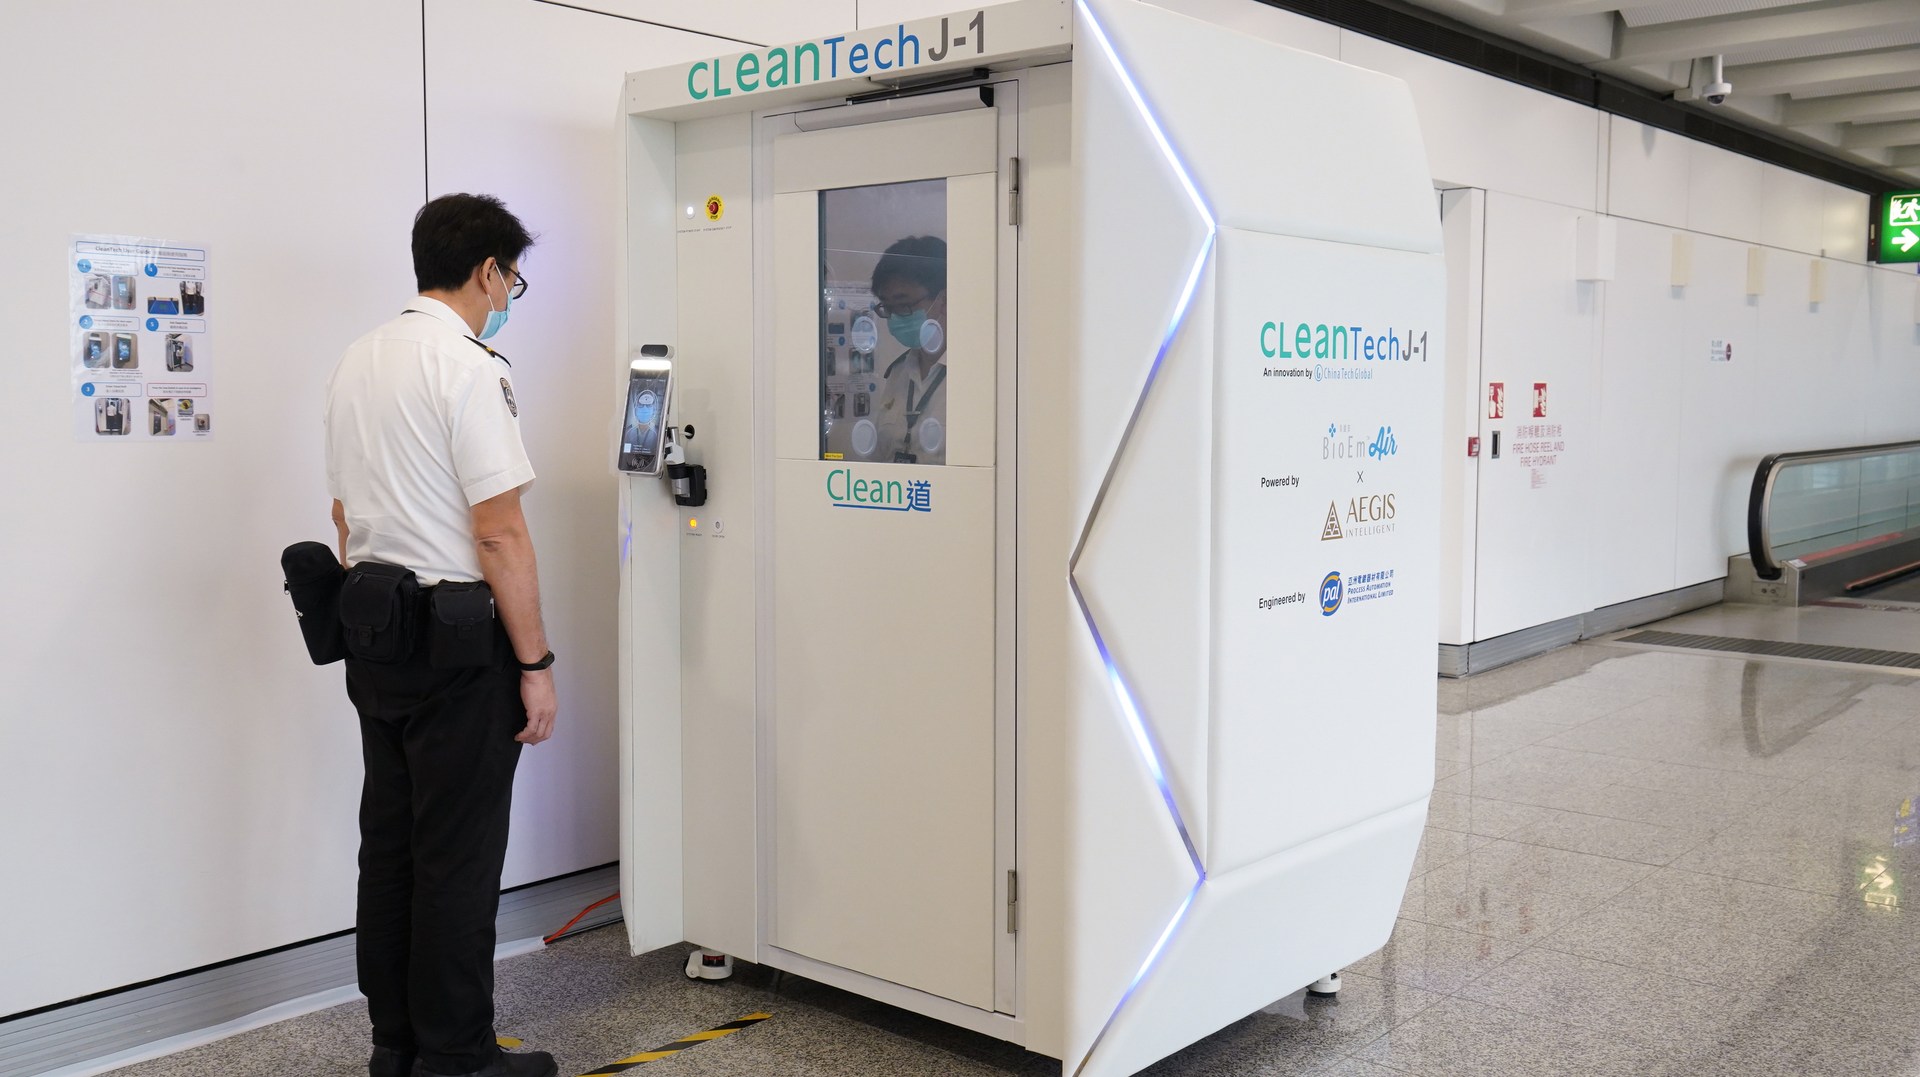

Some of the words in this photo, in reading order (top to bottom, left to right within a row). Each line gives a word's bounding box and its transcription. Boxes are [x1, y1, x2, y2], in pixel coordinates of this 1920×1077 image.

[1263, 367, 1272, 377] An
[1273, 367, 1304, 378] innovation
[1305, 367, 1313, 380] by
[1512, 443, 1524, 454] FIRE
[1525, 442, 1540, 453] HOSE
[1520, 456, 1531, 467] FIRE
[1261, 475, 1290, 488] Powered
[1291, 475, 1300, 488] by
[1346, 493, 1396, 524] AEGIS
[1345, 523, 1396, 538] INTELLIGENT
[1258, 592, 1297, 610] Engineered
[1297, 591, 1306, 604] by
